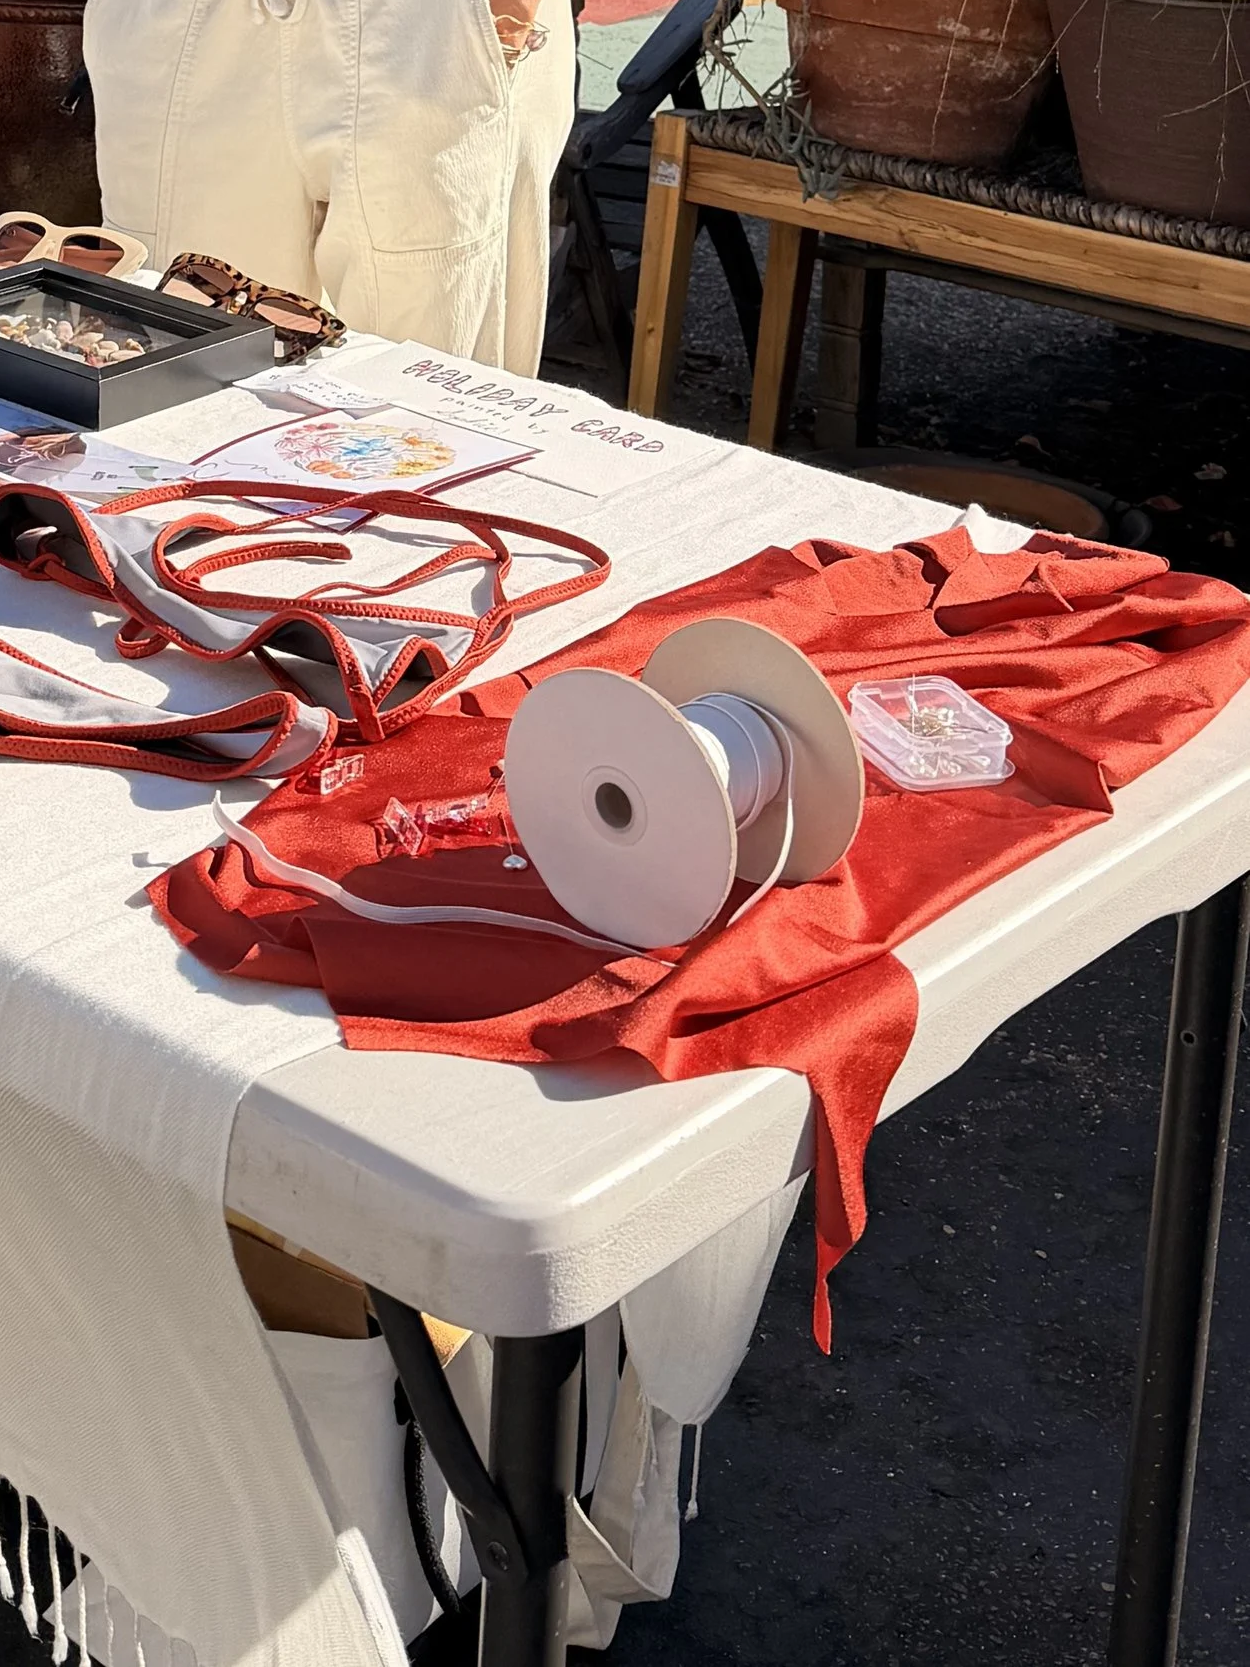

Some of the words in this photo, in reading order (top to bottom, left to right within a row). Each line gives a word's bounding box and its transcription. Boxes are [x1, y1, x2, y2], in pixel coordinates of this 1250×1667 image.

[402, 359, 569, 417] HOLIDAY
[570, 419, 664, 453] CARD
[439, 396, 515, 422] painted
